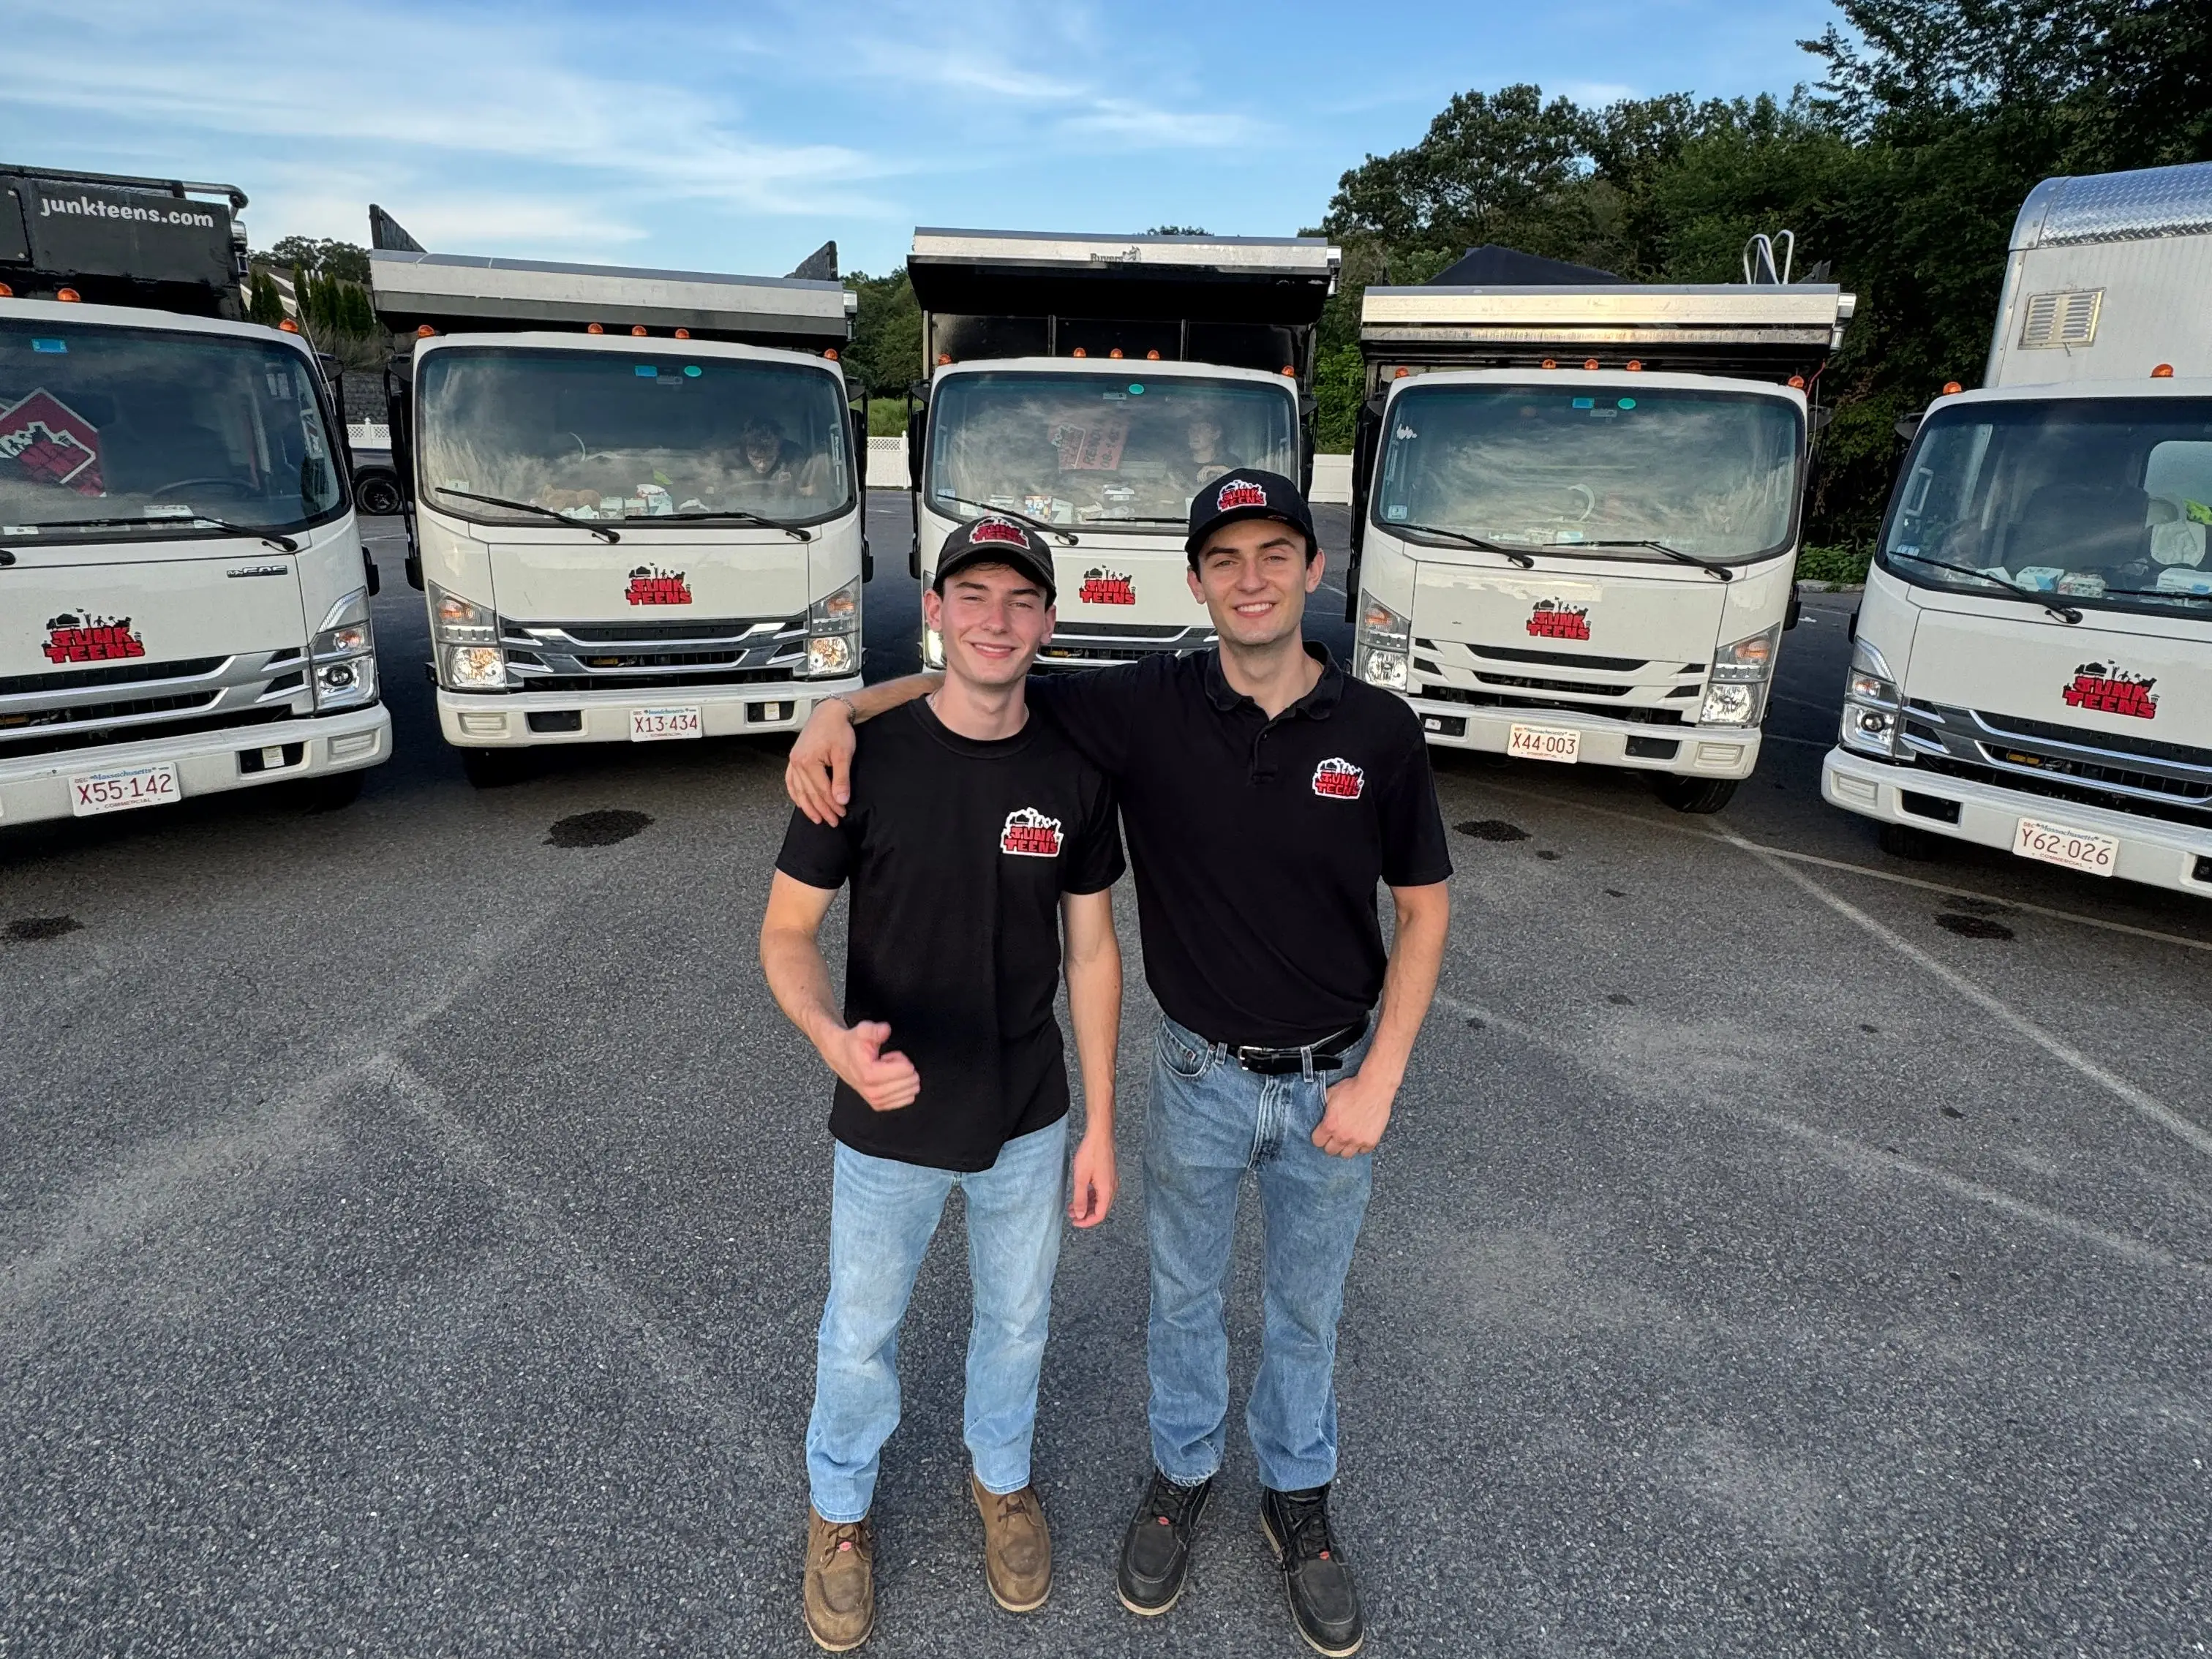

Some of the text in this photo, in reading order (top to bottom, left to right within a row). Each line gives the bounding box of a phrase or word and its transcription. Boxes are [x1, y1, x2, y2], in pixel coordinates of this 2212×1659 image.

[40, 196, 214, 227] junkteens.com
[1223, 488, 1260, 501] JUNK
[631, 579, 686, 592] JUNK
[1084, 579, 1131, 593] JUNK
[626, 591, 692, 605] TEENS
[1080, 591, 1136, 605] TEENS
[1533, 612, 1586, 628] JUNK
[50, 627, 134, 647] JUNK
[1527, 623, 1590, 641] TEENS
[44, 641, 146, 663] TEENS
[2073, 676, 2151, 703] JUNK
[2063, 689, 2156, 720] TEENS
[92, 768, 152, 780] Massachusetts
[1320, 772, 1359, 786] JUNK
[1316, 782, 1360, 797] TEENS
[1011, 826, 1055, 842] JUNK
[2039, 824, 2096, 841] Massachusetts
[1004, 838, 1058, 854] TEENS
